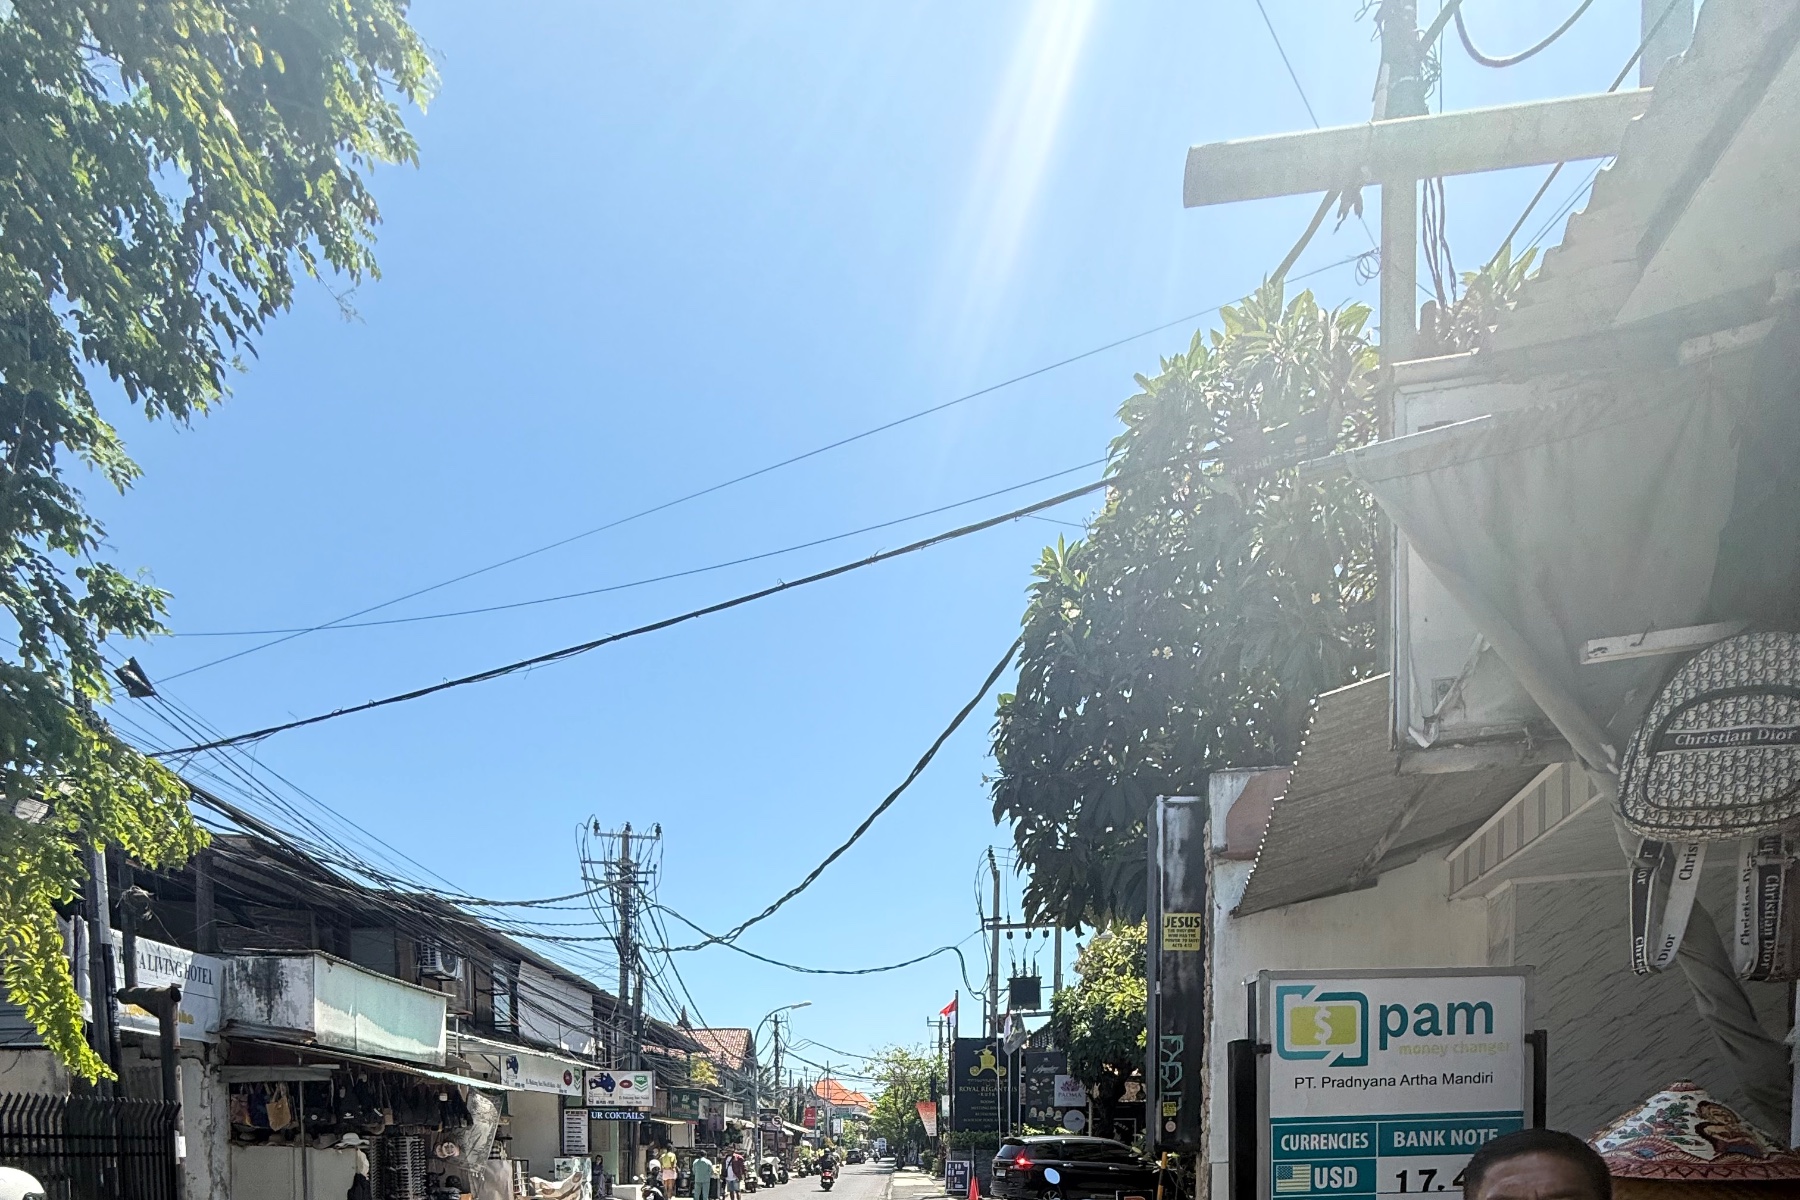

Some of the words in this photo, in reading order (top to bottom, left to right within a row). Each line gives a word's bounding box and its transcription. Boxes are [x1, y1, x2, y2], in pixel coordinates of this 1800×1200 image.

[1675, 730, 1751, 746] Christian
[1757, 727, 1797, 741] Dior
[1763, 874, 1780, 937] Christian
[1164, 916, 1201, 928] JESUS
[1761, 939, 1775, 969] Dior
[148, 953, 183, 978] LIVING
[184, 963, 214, 986] HOTEL
[1379, 1000, 1494, 1051] pam
[1399, 1043, 1449, 1057] money
[1453, 1041, 1511, 1056] changer
[1294, 1076, 1317, 1089] PT.
[1321, 1074, 1396, 1090] Pradnyana
[1400, 1073, 1437, 1087] Artha
[1442, 1071, 1494, 1085] Mandiri
[591, 1112, 603, 1120] UR
[605, 1112, 645, 1120] COKTAILS
[1280, 1132, 1369, 1151] CURRENCIES
[1393, 1130, 1446, 1148] BANK
[1314, 1166, 1358, 1190] USD
